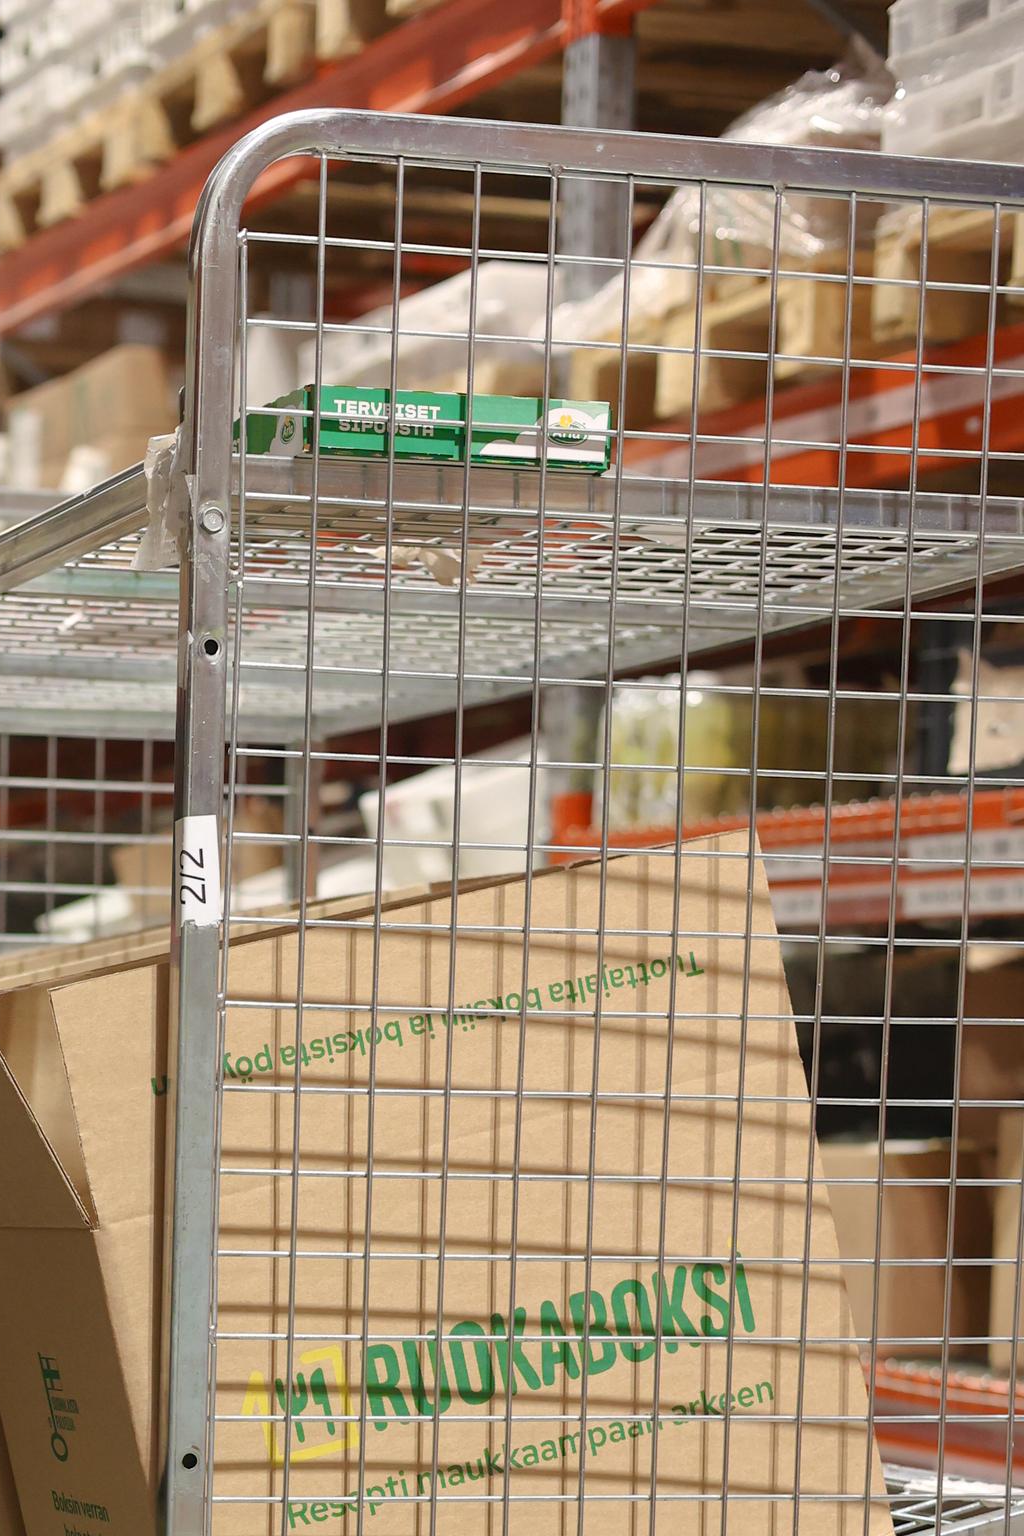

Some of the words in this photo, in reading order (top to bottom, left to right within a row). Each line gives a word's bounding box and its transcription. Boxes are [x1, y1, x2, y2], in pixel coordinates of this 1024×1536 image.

[333, 399, 441, 420] TERVEISET
[179, 848, 207, 905] 2/2
[548, 950, 705, 1005] Tuottajalta
[279, 1020, 404, 1067] boksista
[409, 1009, 436, 1040] ja
[360, 1238, 756, 1433] RUOKABOKSI
[287, 1469, 409, 1529] Resepti
[416, 1411, 664, 1495] maukkaampaan
[671, 1381, 774, 1426] arkeen
